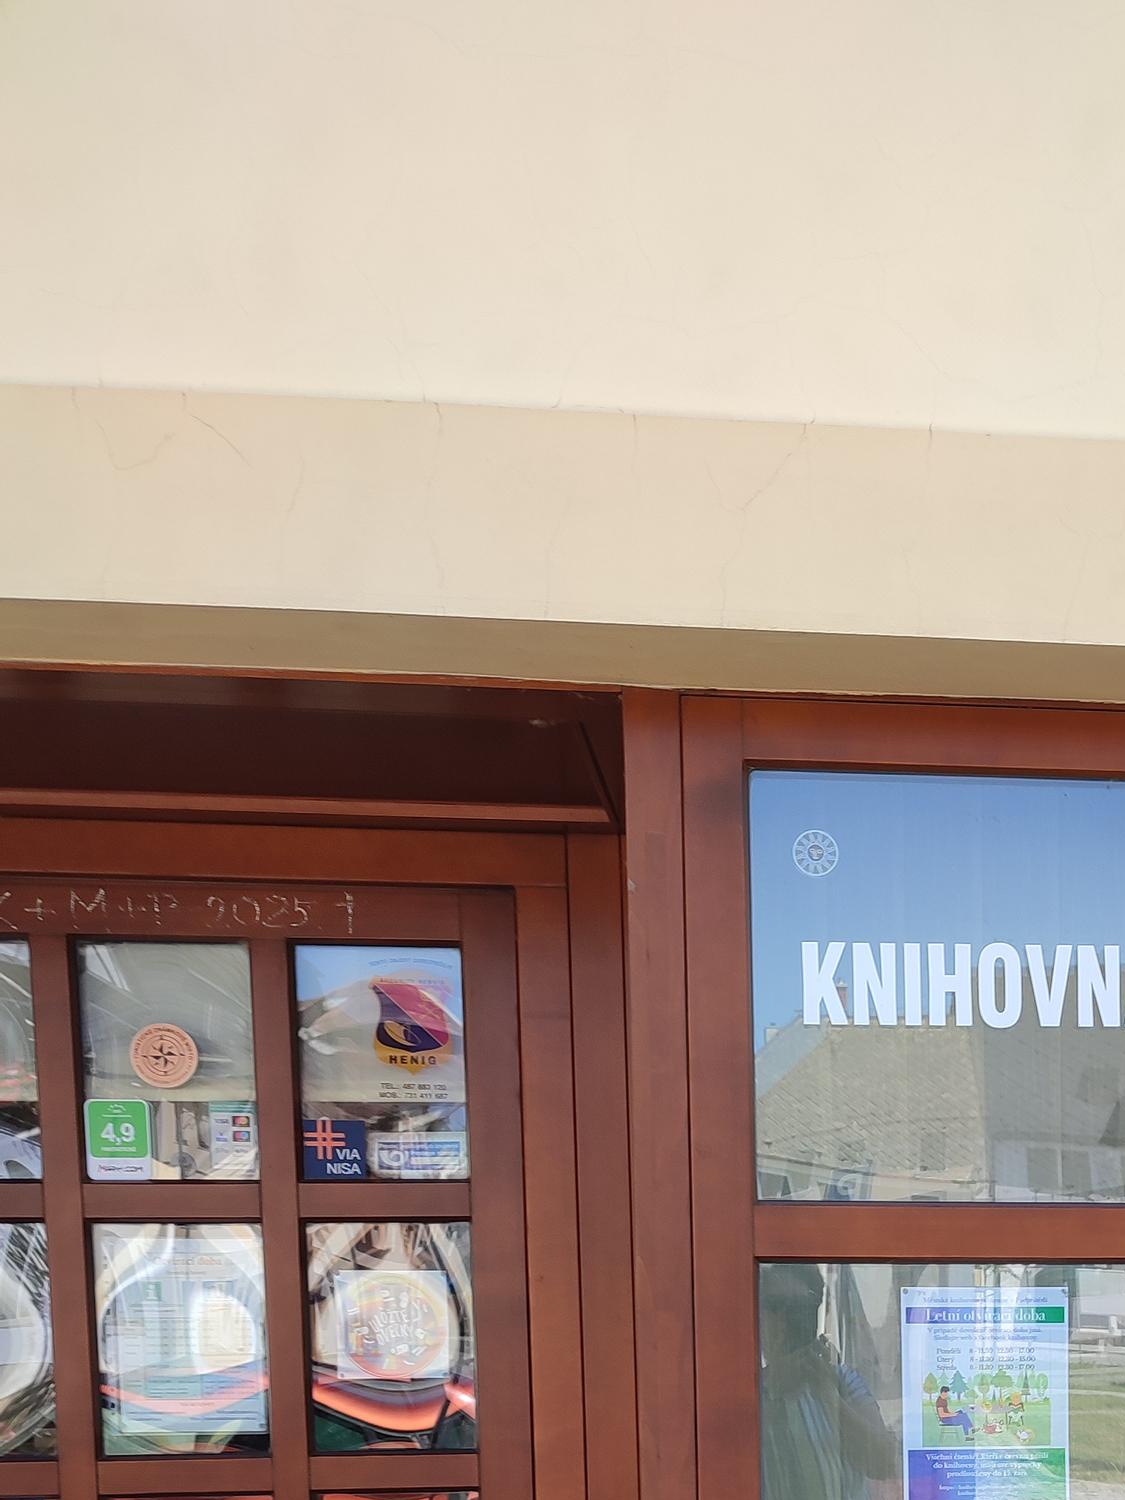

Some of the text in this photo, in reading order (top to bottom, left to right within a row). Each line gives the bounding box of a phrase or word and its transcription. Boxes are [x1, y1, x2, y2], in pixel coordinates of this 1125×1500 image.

[389, 1056, 437, 1065] HENIG
[101, 1123, 136, 1145] 4,9
[336, 1149, 361, 1160] VIA
[327, 1162, 361, 1175] NISA
[926, 1309, 960, 1321] Letní
[1015, 1309, 1046, 1321] doba
